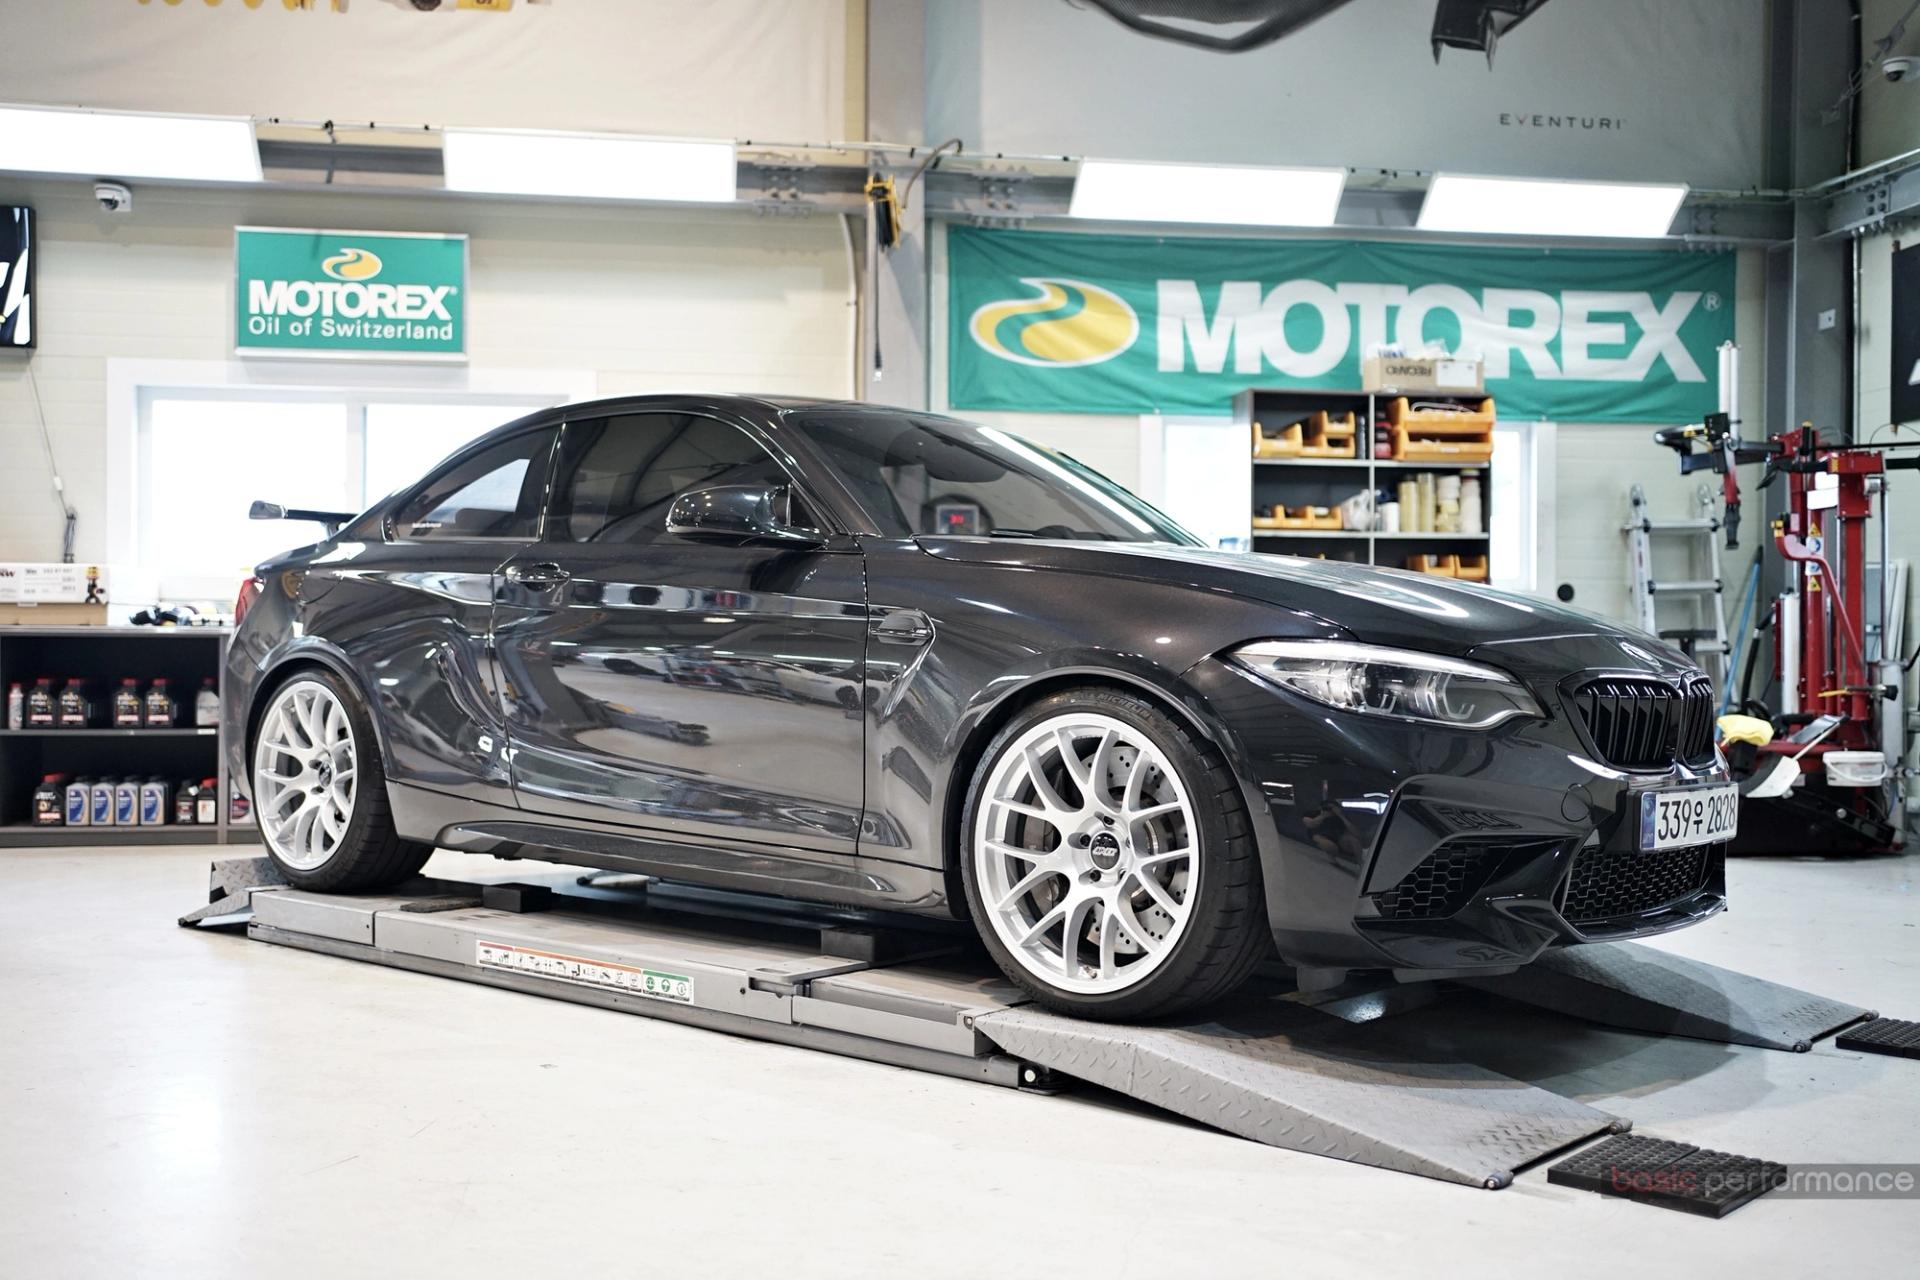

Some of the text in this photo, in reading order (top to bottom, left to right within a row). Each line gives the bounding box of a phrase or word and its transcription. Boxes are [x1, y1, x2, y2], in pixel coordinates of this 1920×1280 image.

[1499, 112, 1621, 129] EVENTURI
[249, 279, 452, 320] MOTOREX
[248, 316, 453, 341] Oil of Switzerland
[1156, 279, 1707, 383] MOTOREX
[1096, 692, 1153, 718] MICHELIN
